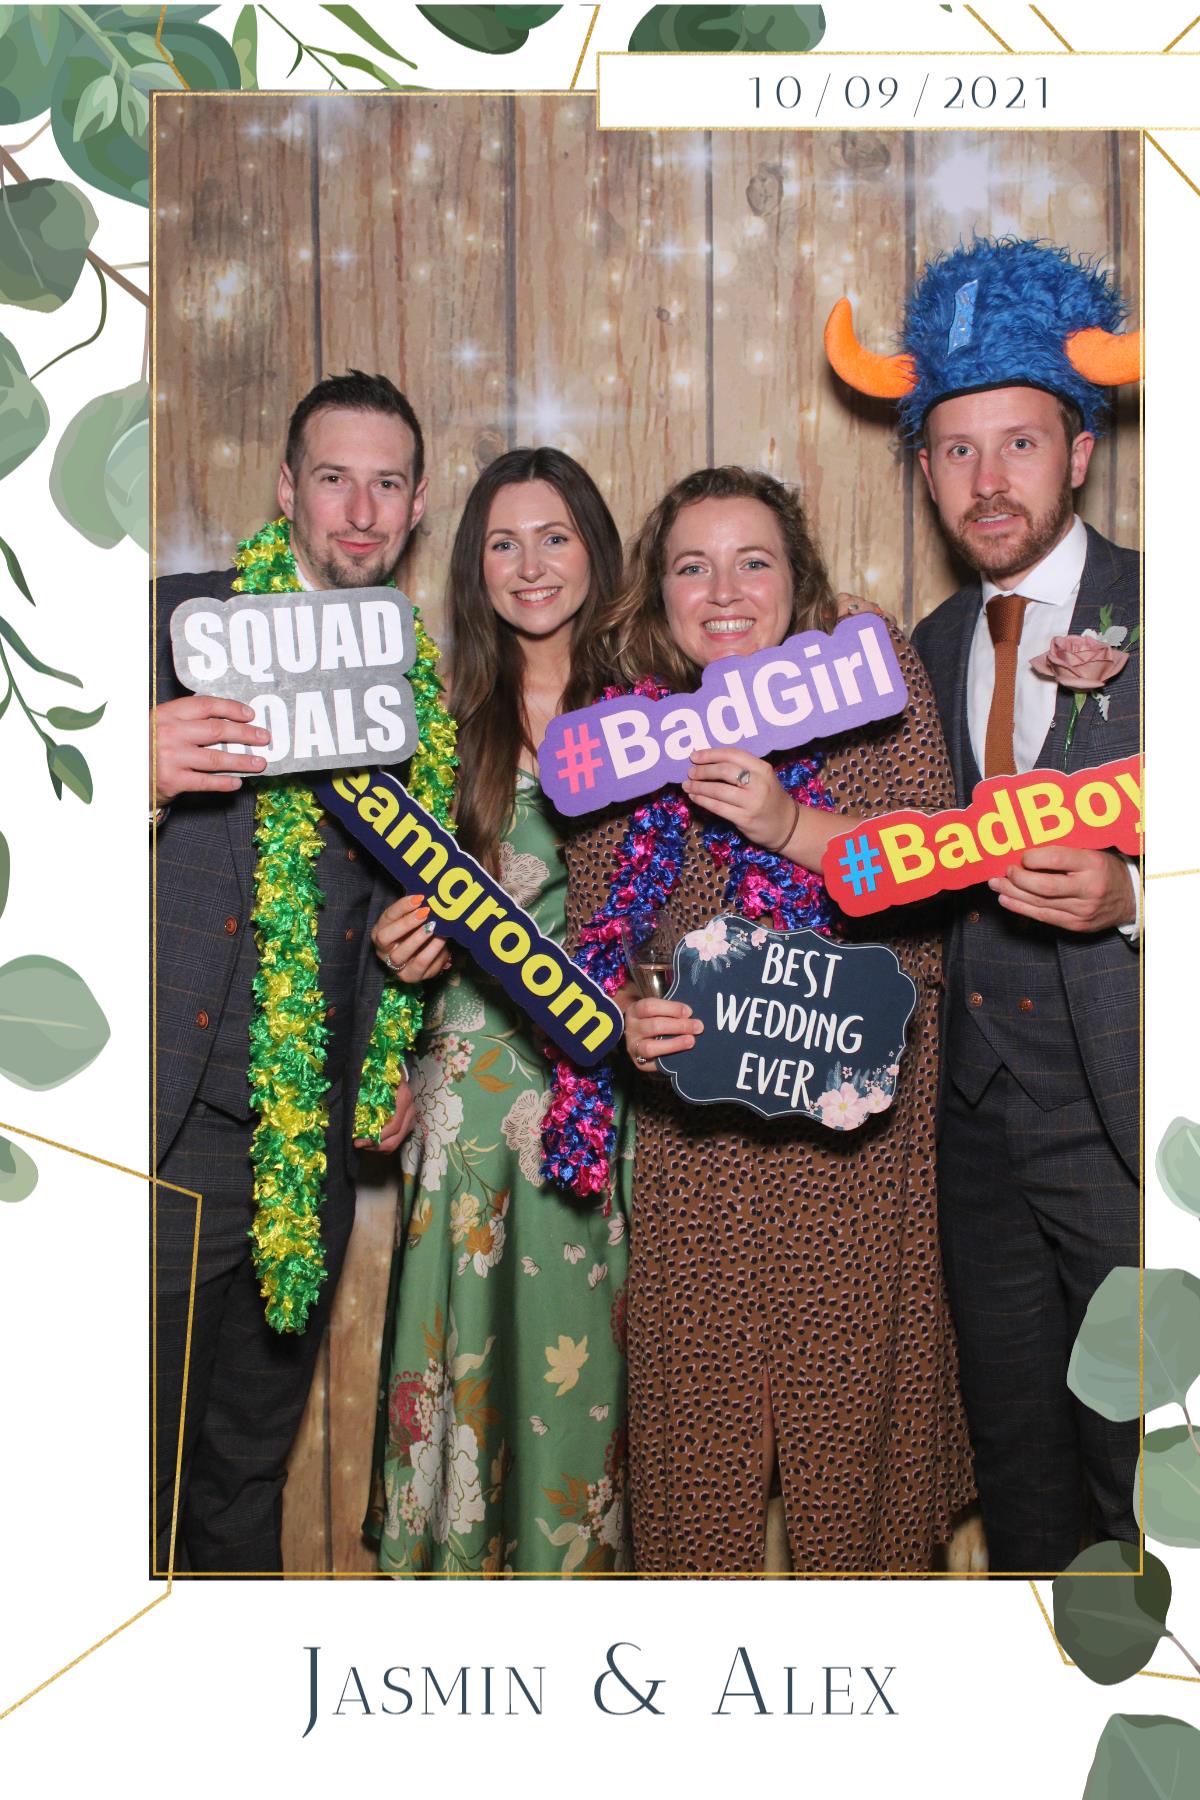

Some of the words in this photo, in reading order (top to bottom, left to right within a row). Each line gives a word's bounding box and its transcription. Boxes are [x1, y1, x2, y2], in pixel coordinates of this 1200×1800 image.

[179, 600, 404, 683] SQUAD
[204, 684, 406, 763] OALS
[556, 627, 894, 794] #BadGirl
[331, 769, 613, 1053] eamgroom
[761, 942, 843, 999] BEST
[716, 992, 864, 1054] WEDDING
[736, 1052, 815, 1108] EVER
